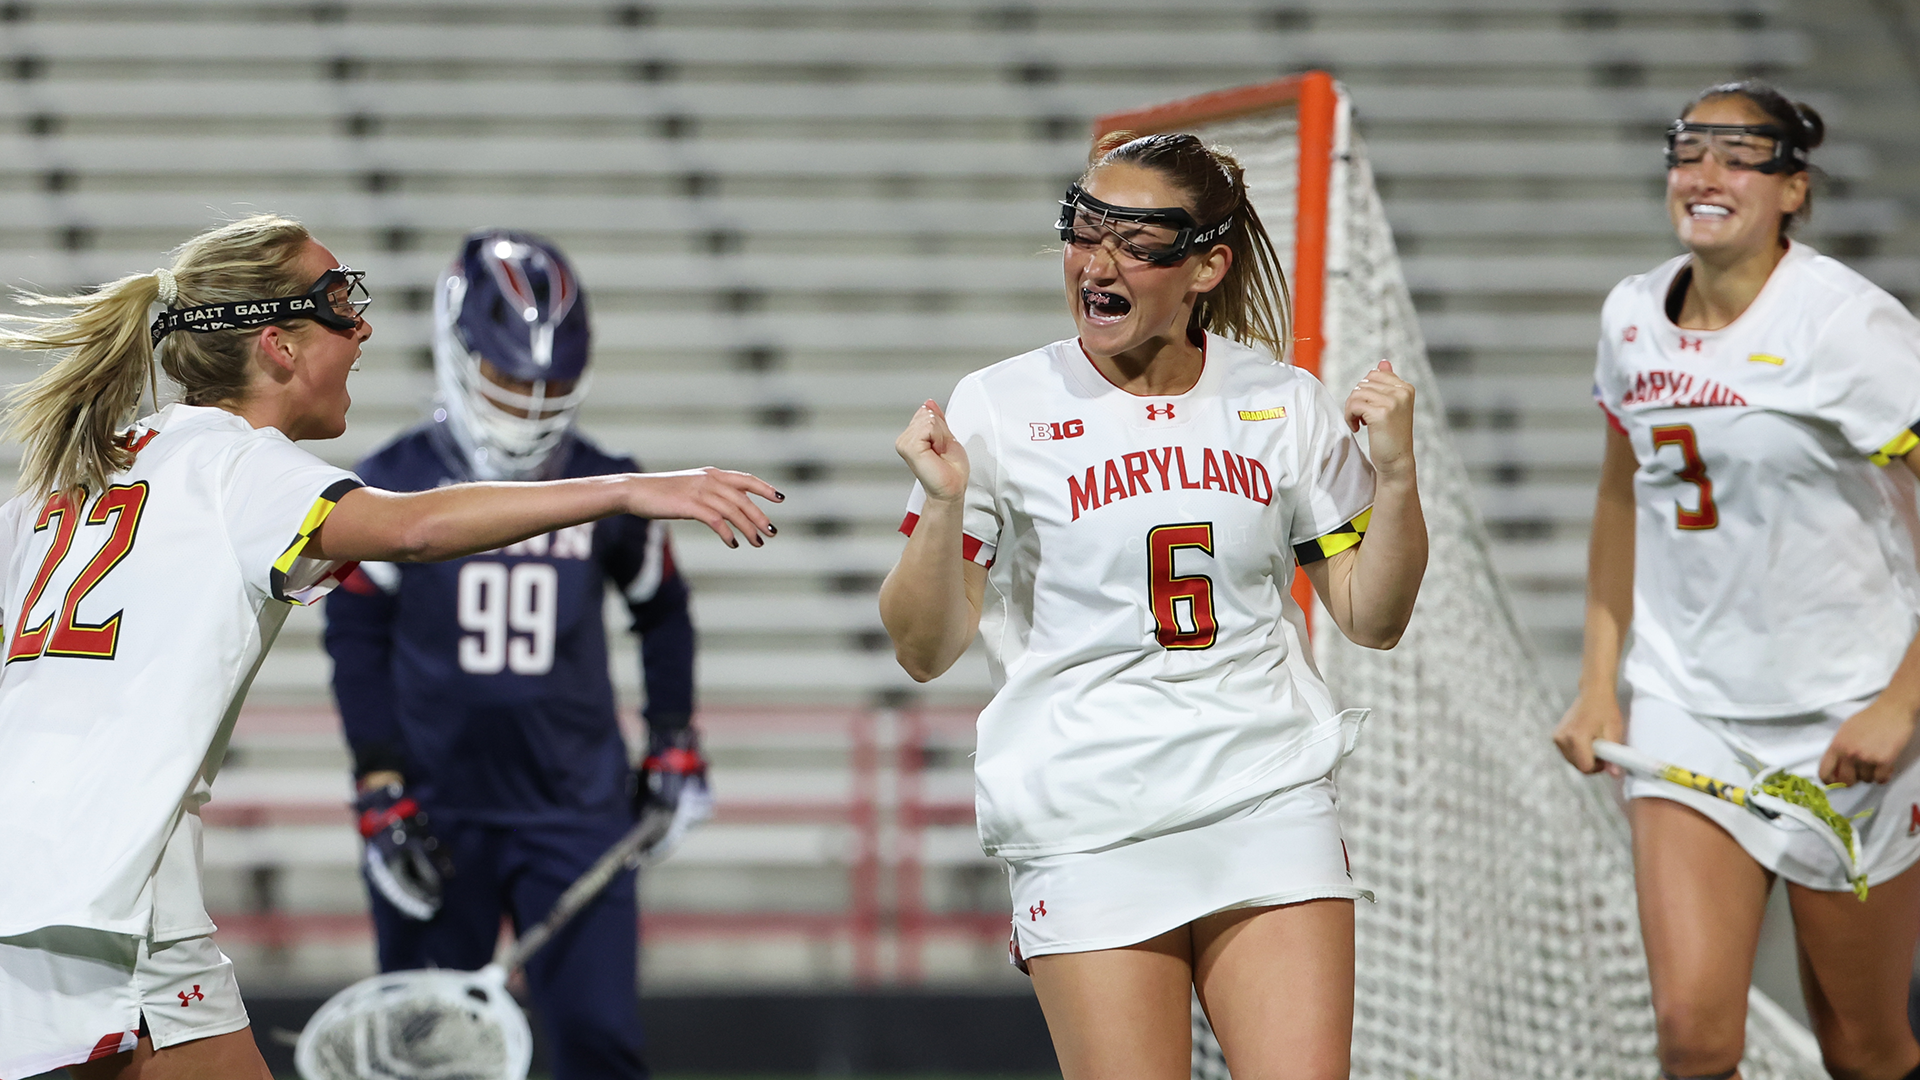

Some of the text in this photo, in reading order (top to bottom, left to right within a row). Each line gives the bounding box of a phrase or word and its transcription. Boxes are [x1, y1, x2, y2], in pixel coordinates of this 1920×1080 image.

[1194, 228, 1215, 243] AIT
[184, 307, 225, 323] GAIT
[235, 302, 280, 315] GAIT
[290, 299, 315, 310] GA
[1239, 407, 1286, 420] GRADUATE
[1067, 446, 1273, 522] MARYLAND
[1652, 424, 1718, 530] 3
[5, 480, 149, 667] 22
[458, 562, 557, 675] 99
[1146, 522, 1218, 650] 6
